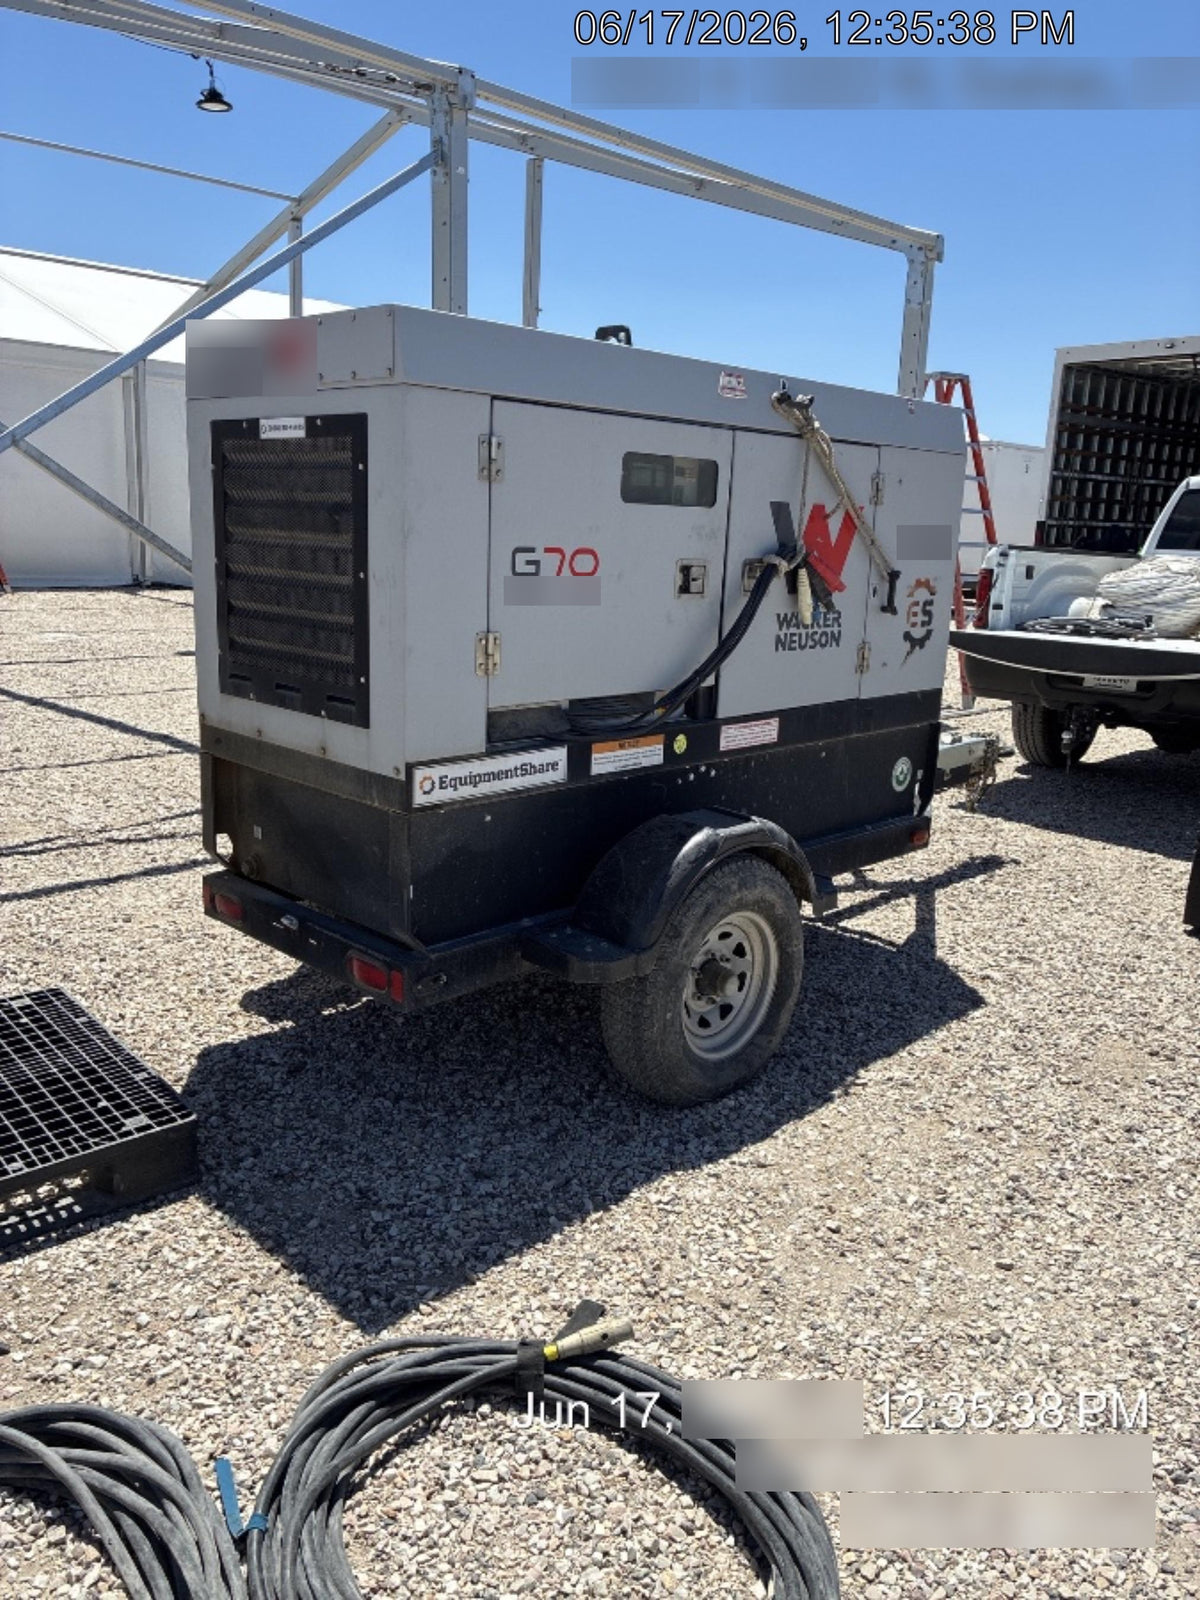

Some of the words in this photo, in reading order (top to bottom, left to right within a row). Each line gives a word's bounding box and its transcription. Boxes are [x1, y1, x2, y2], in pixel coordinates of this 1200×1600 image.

[511, 547, 599, 576] G70
[775, 630, 842, 652] NEUSON
[438, 759, 560, 792] EquipmentShare
